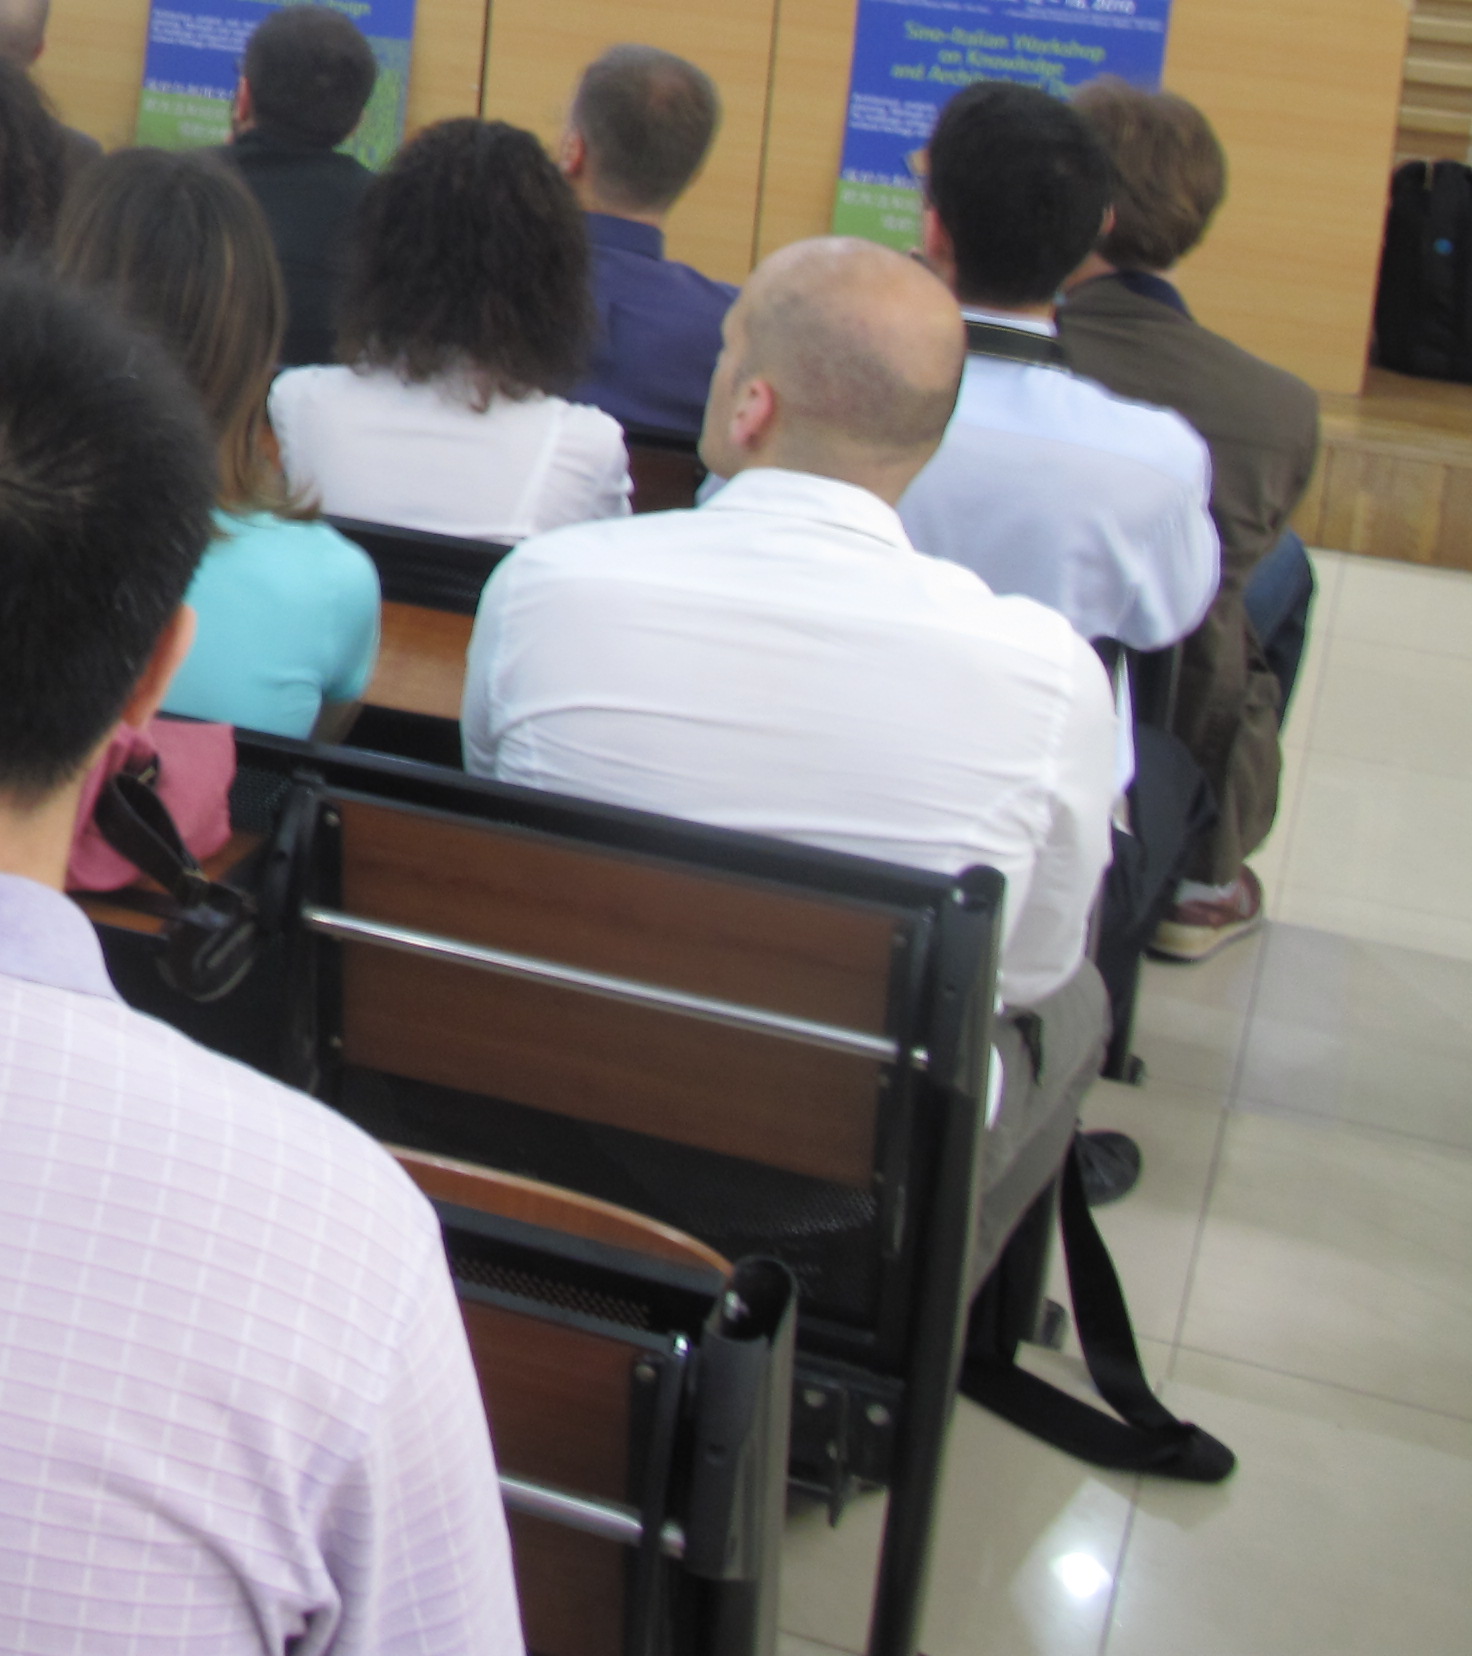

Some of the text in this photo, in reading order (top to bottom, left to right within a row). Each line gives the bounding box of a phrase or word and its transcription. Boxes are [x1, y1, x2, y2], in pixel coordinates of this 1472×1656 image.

[905, 21, 1105, 65] Sino-Italian Workshop
[890, 64, 925, 80] and
[938, 48, 1064, 77] on Knowledge
